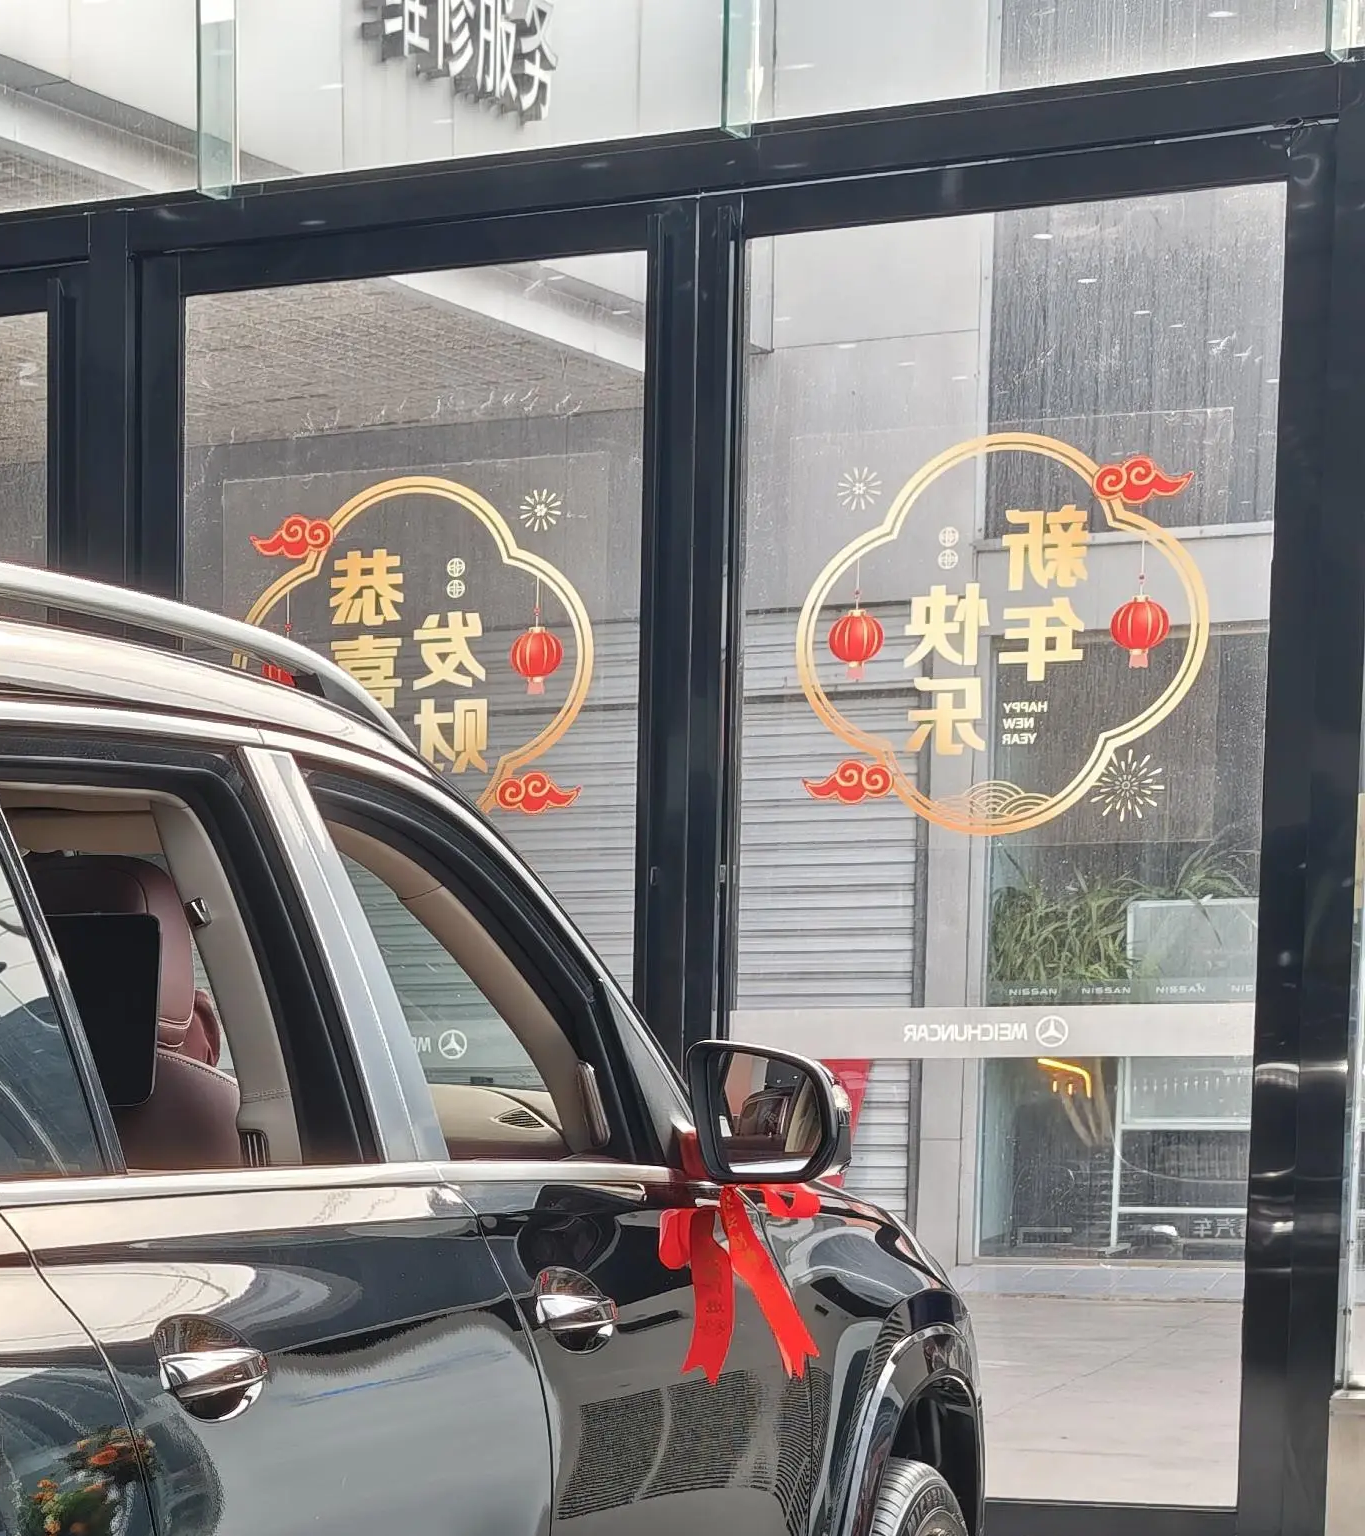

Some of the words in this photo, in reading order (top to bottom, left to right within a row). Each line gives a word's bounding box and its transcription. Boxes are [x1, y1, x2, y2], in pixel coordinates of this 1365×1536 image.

[1009, 987, 1058, 996] NISSAN
[1081, 986, 1131, 995] NISSAN
[1156, 985, 1206, 994] NISSAN
[1231, 984, 1254, 993] NIS
